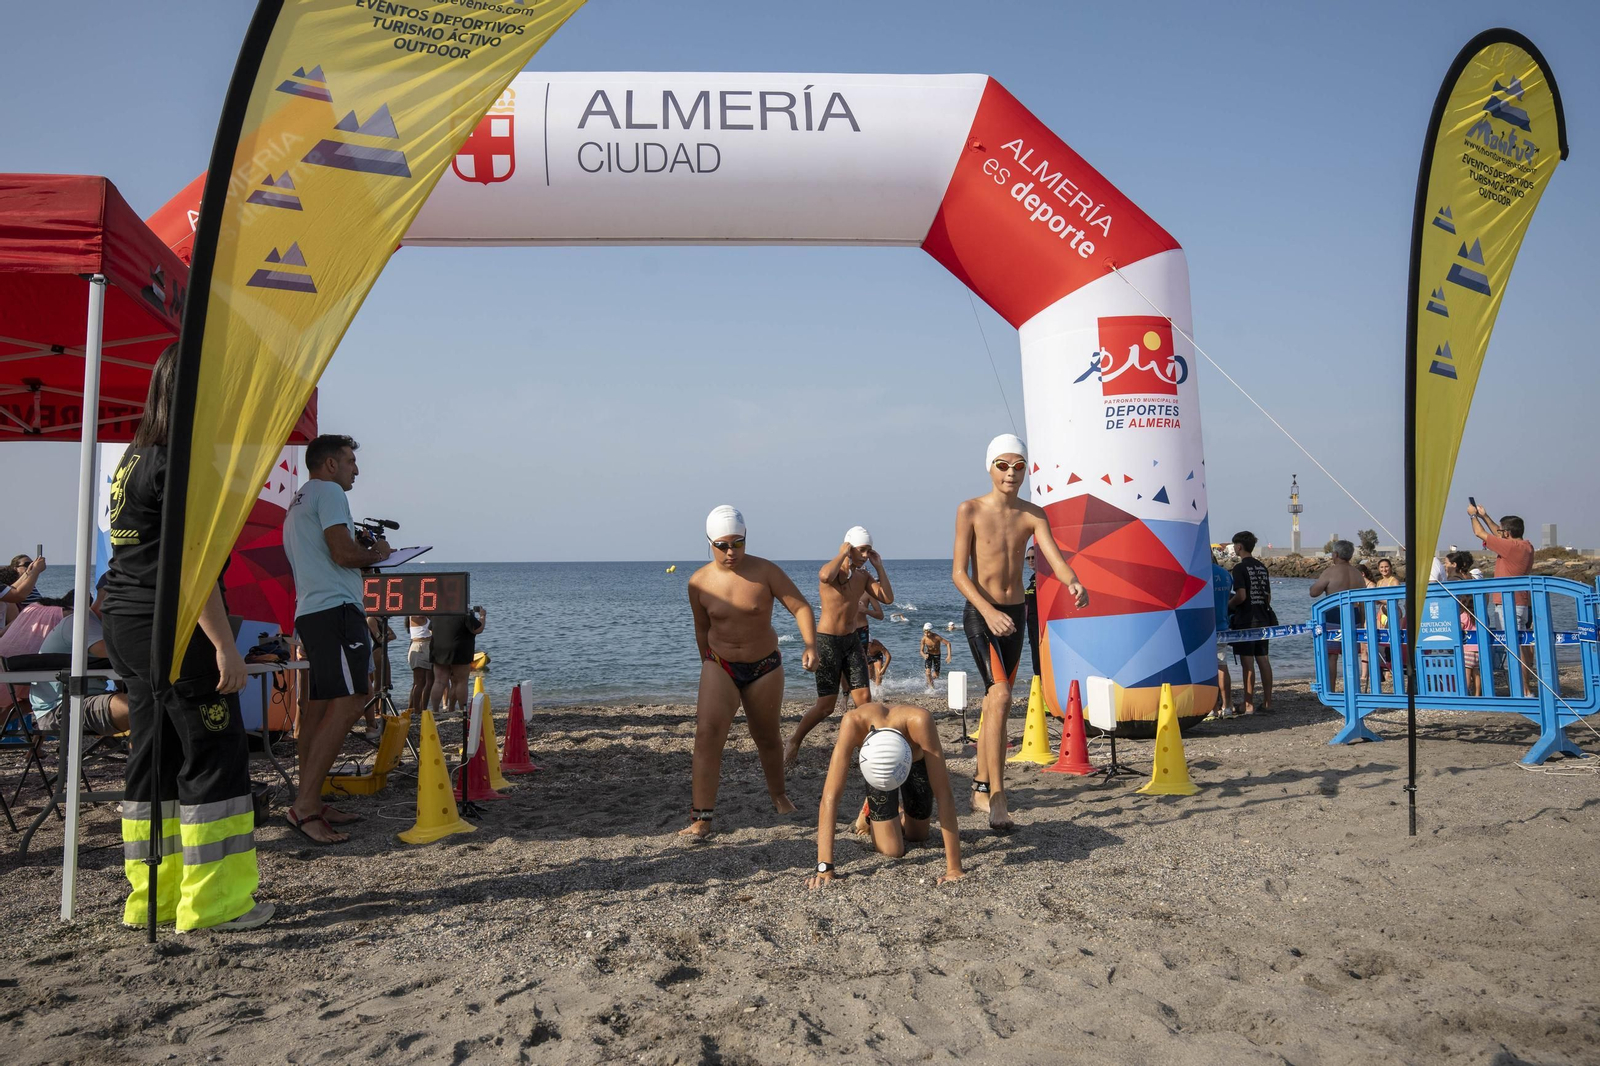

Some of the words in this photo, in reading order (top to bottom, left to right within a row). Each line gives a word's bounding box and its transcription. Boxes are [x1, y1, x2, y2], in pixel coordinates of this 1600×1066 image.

[355, 0, 430, 21] EVENTOS
[432, 12, 526, 35] DEPORTIVOS
[372, 16, 445, 40] TURISMO
[446, 28, 502, 47] ÁCTIVO
[393, 37, 472, 59] OUTDOOR
[577, 84, 861, 132] ALMERÍA
[577, 141, 721, 173] CIUDAD
[1462, 153, 1495, 176] EVENTOS
[1493, 169, 1535, 190] DEPORTIVOS
[1000, 138, 1113, 238] ALMERÍA
[1469, 169, 1500, 191] TURISMO
[982, 158, 1011, 185] es
[1010, 182, 1095, 259] deporte
[1478, 187, 1512, 206] OUTDOOR
[1105, 404, 1180, 418] DEPORTES
[1106, 418, 1125, 430] DE
[1128, 418, 1181, 429] ALMERIA
